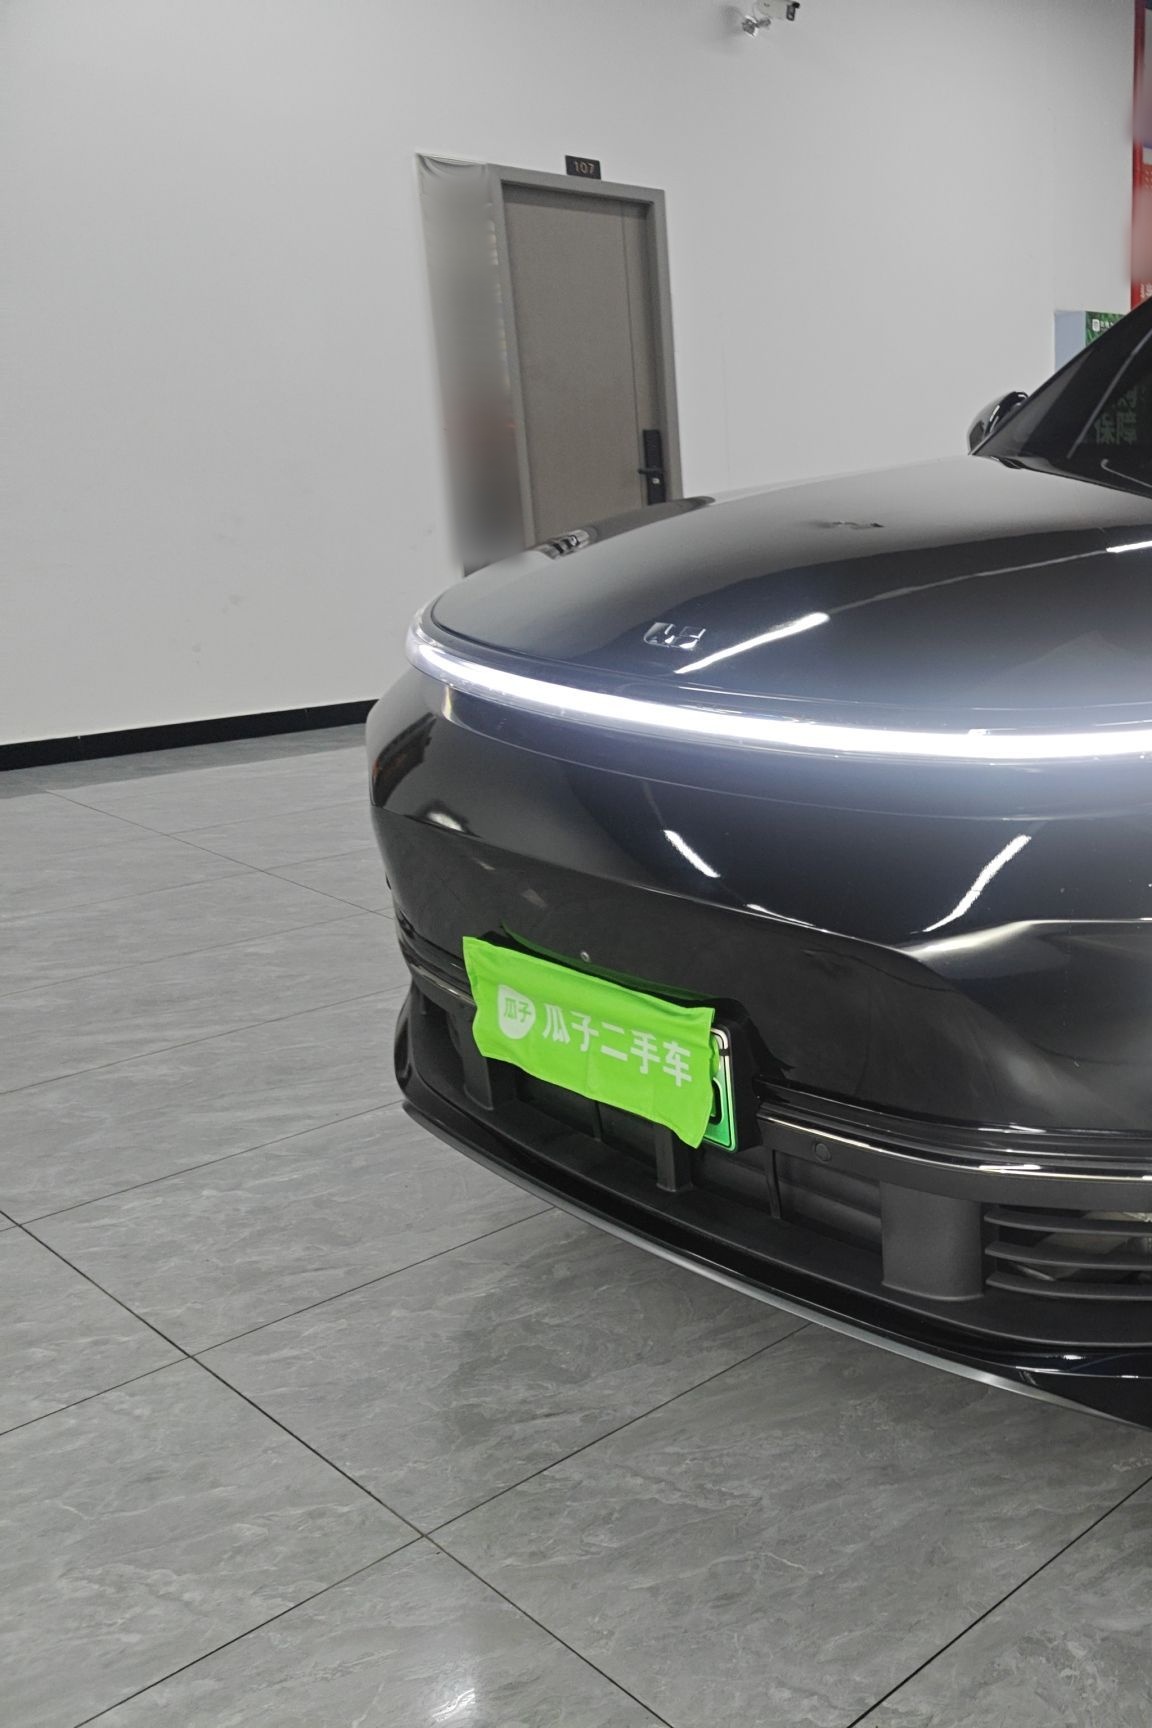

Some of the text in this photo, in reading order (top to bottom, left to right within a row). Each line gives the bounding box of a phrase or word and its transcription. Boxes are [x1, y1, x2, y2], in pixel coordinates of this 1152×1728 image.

[574, 160, 595, 175] 107
[503, 997, 532, 1022] 瓜子
[542, 1003, 692, 1087] 瓜子二手车
